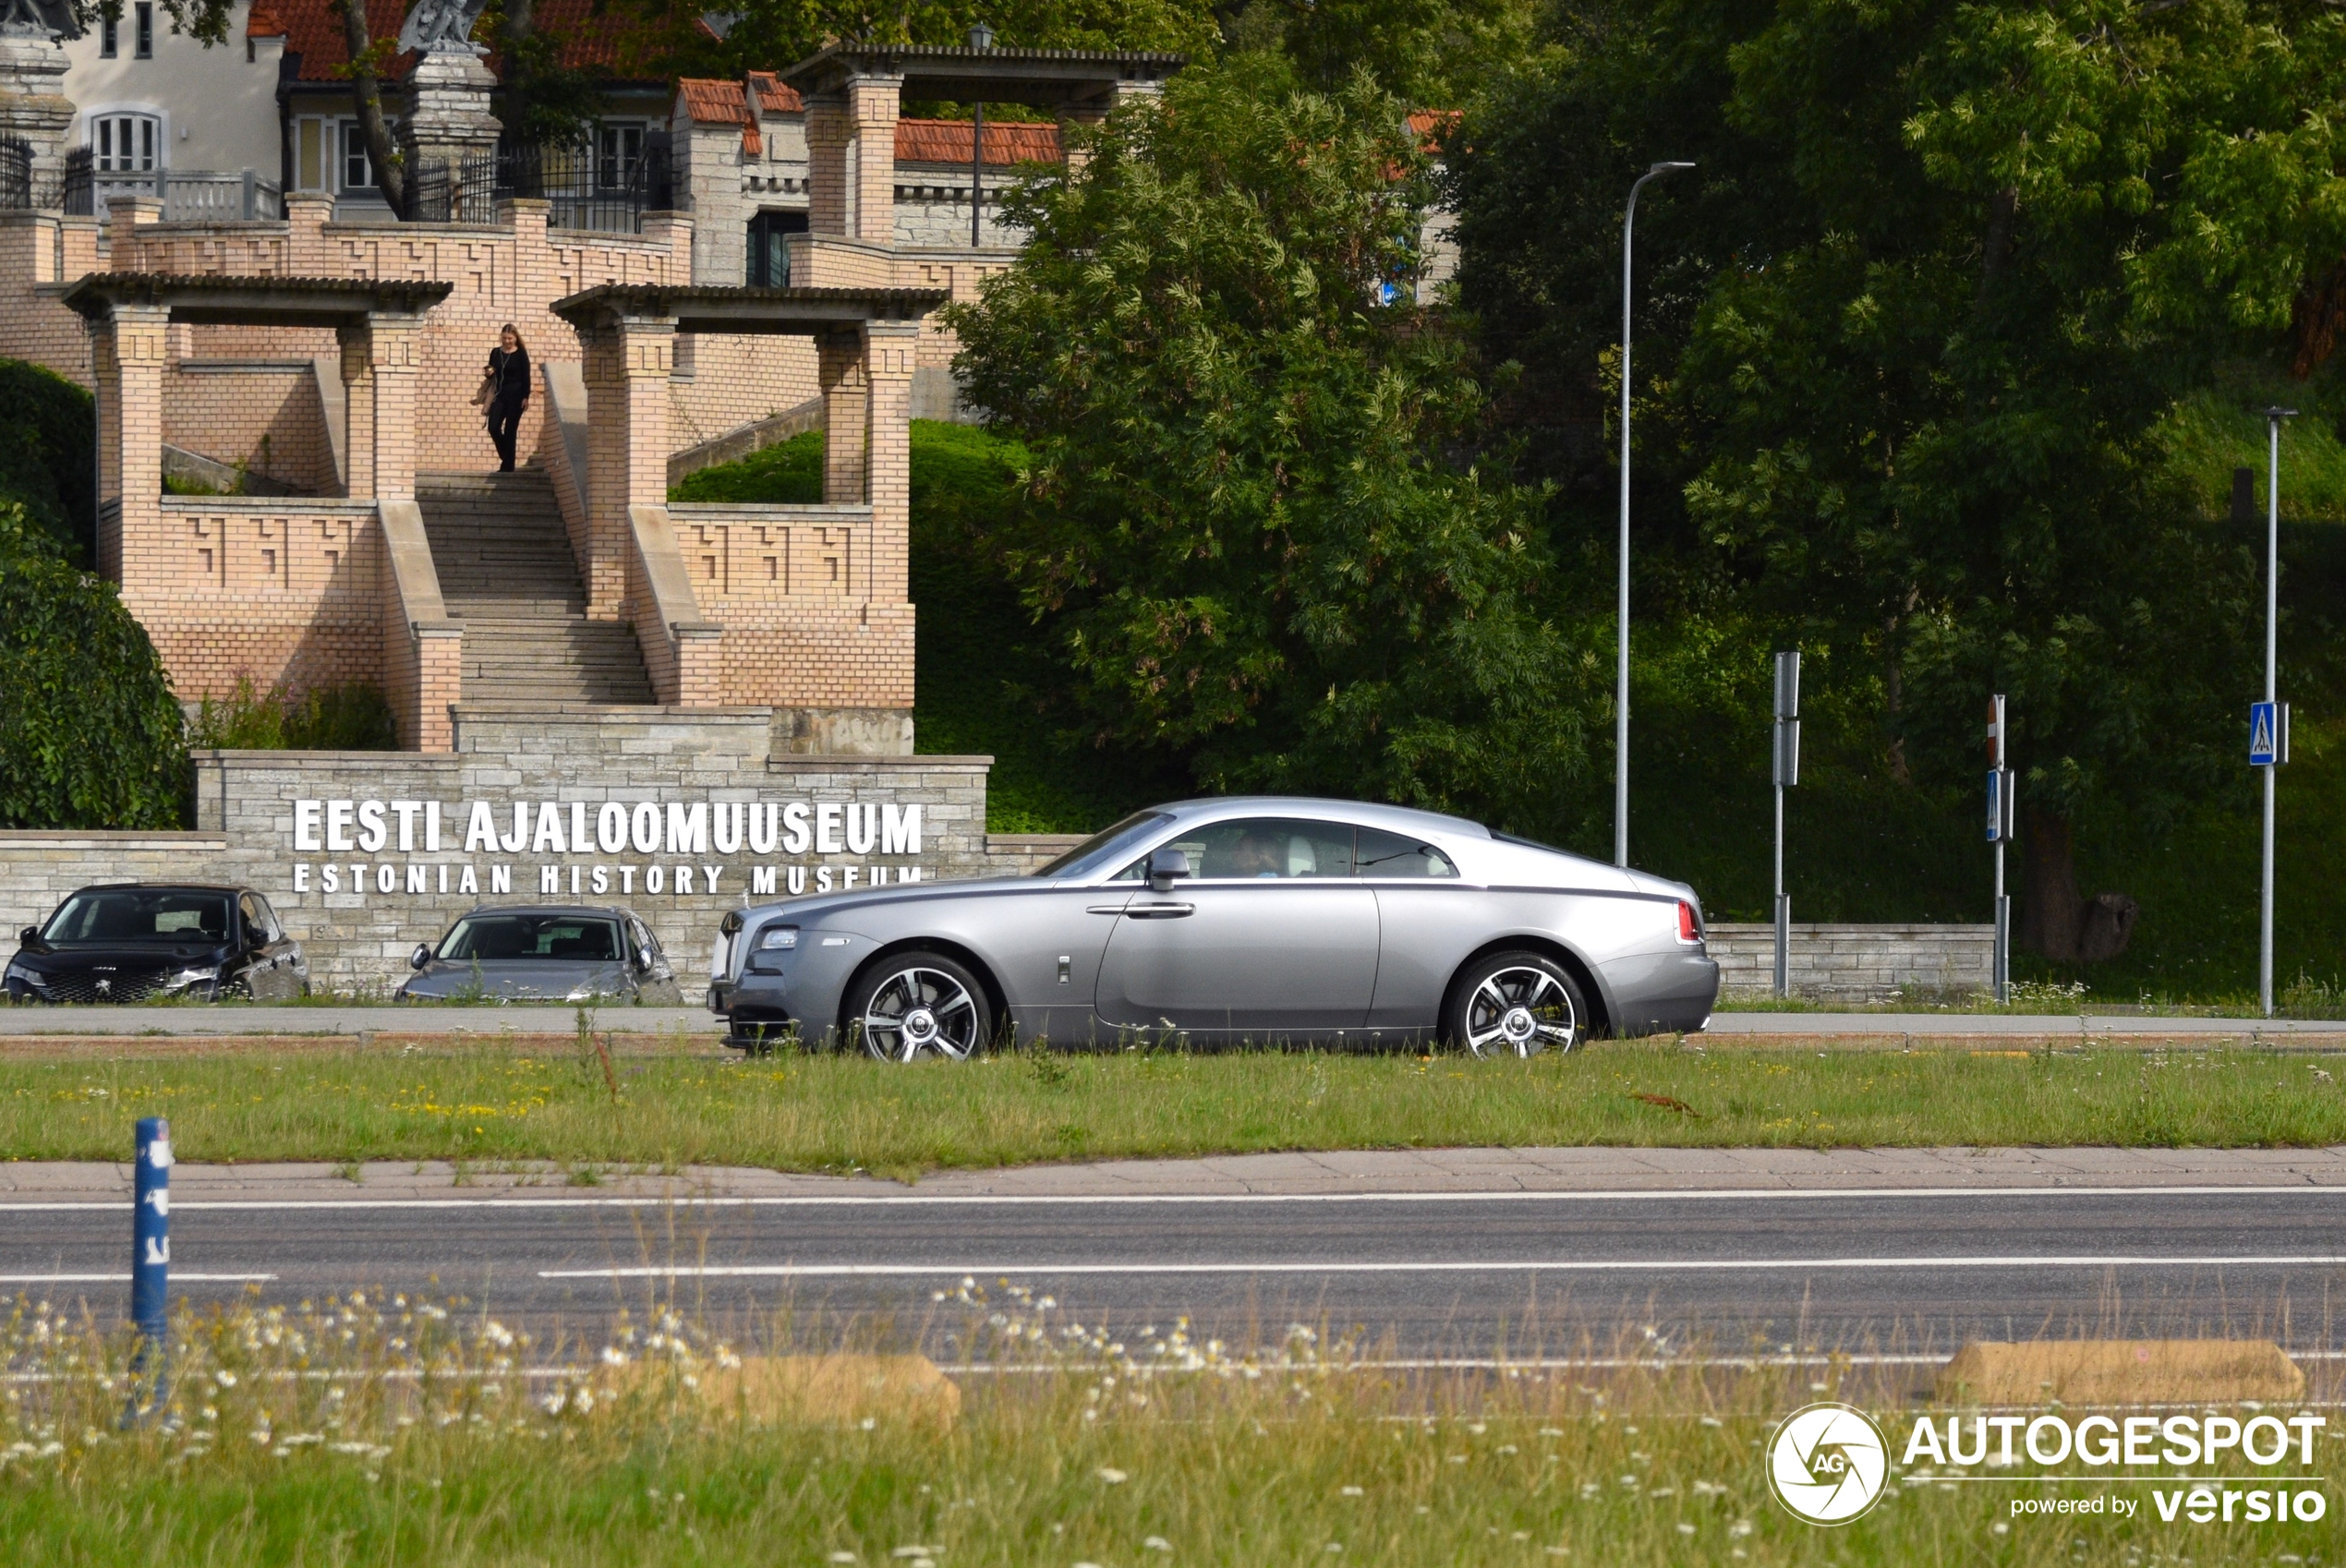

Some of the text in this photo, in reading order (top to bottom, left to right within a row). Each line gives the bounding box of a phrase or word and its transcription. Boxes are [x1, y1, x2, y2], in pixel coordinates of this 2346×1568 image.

[295, 800, 922, 854] EESTI AJALOOMUUSEUM
[295, 863, 511, 893] ESTONIAN
[541, 865, 723, 895] HISTORY
